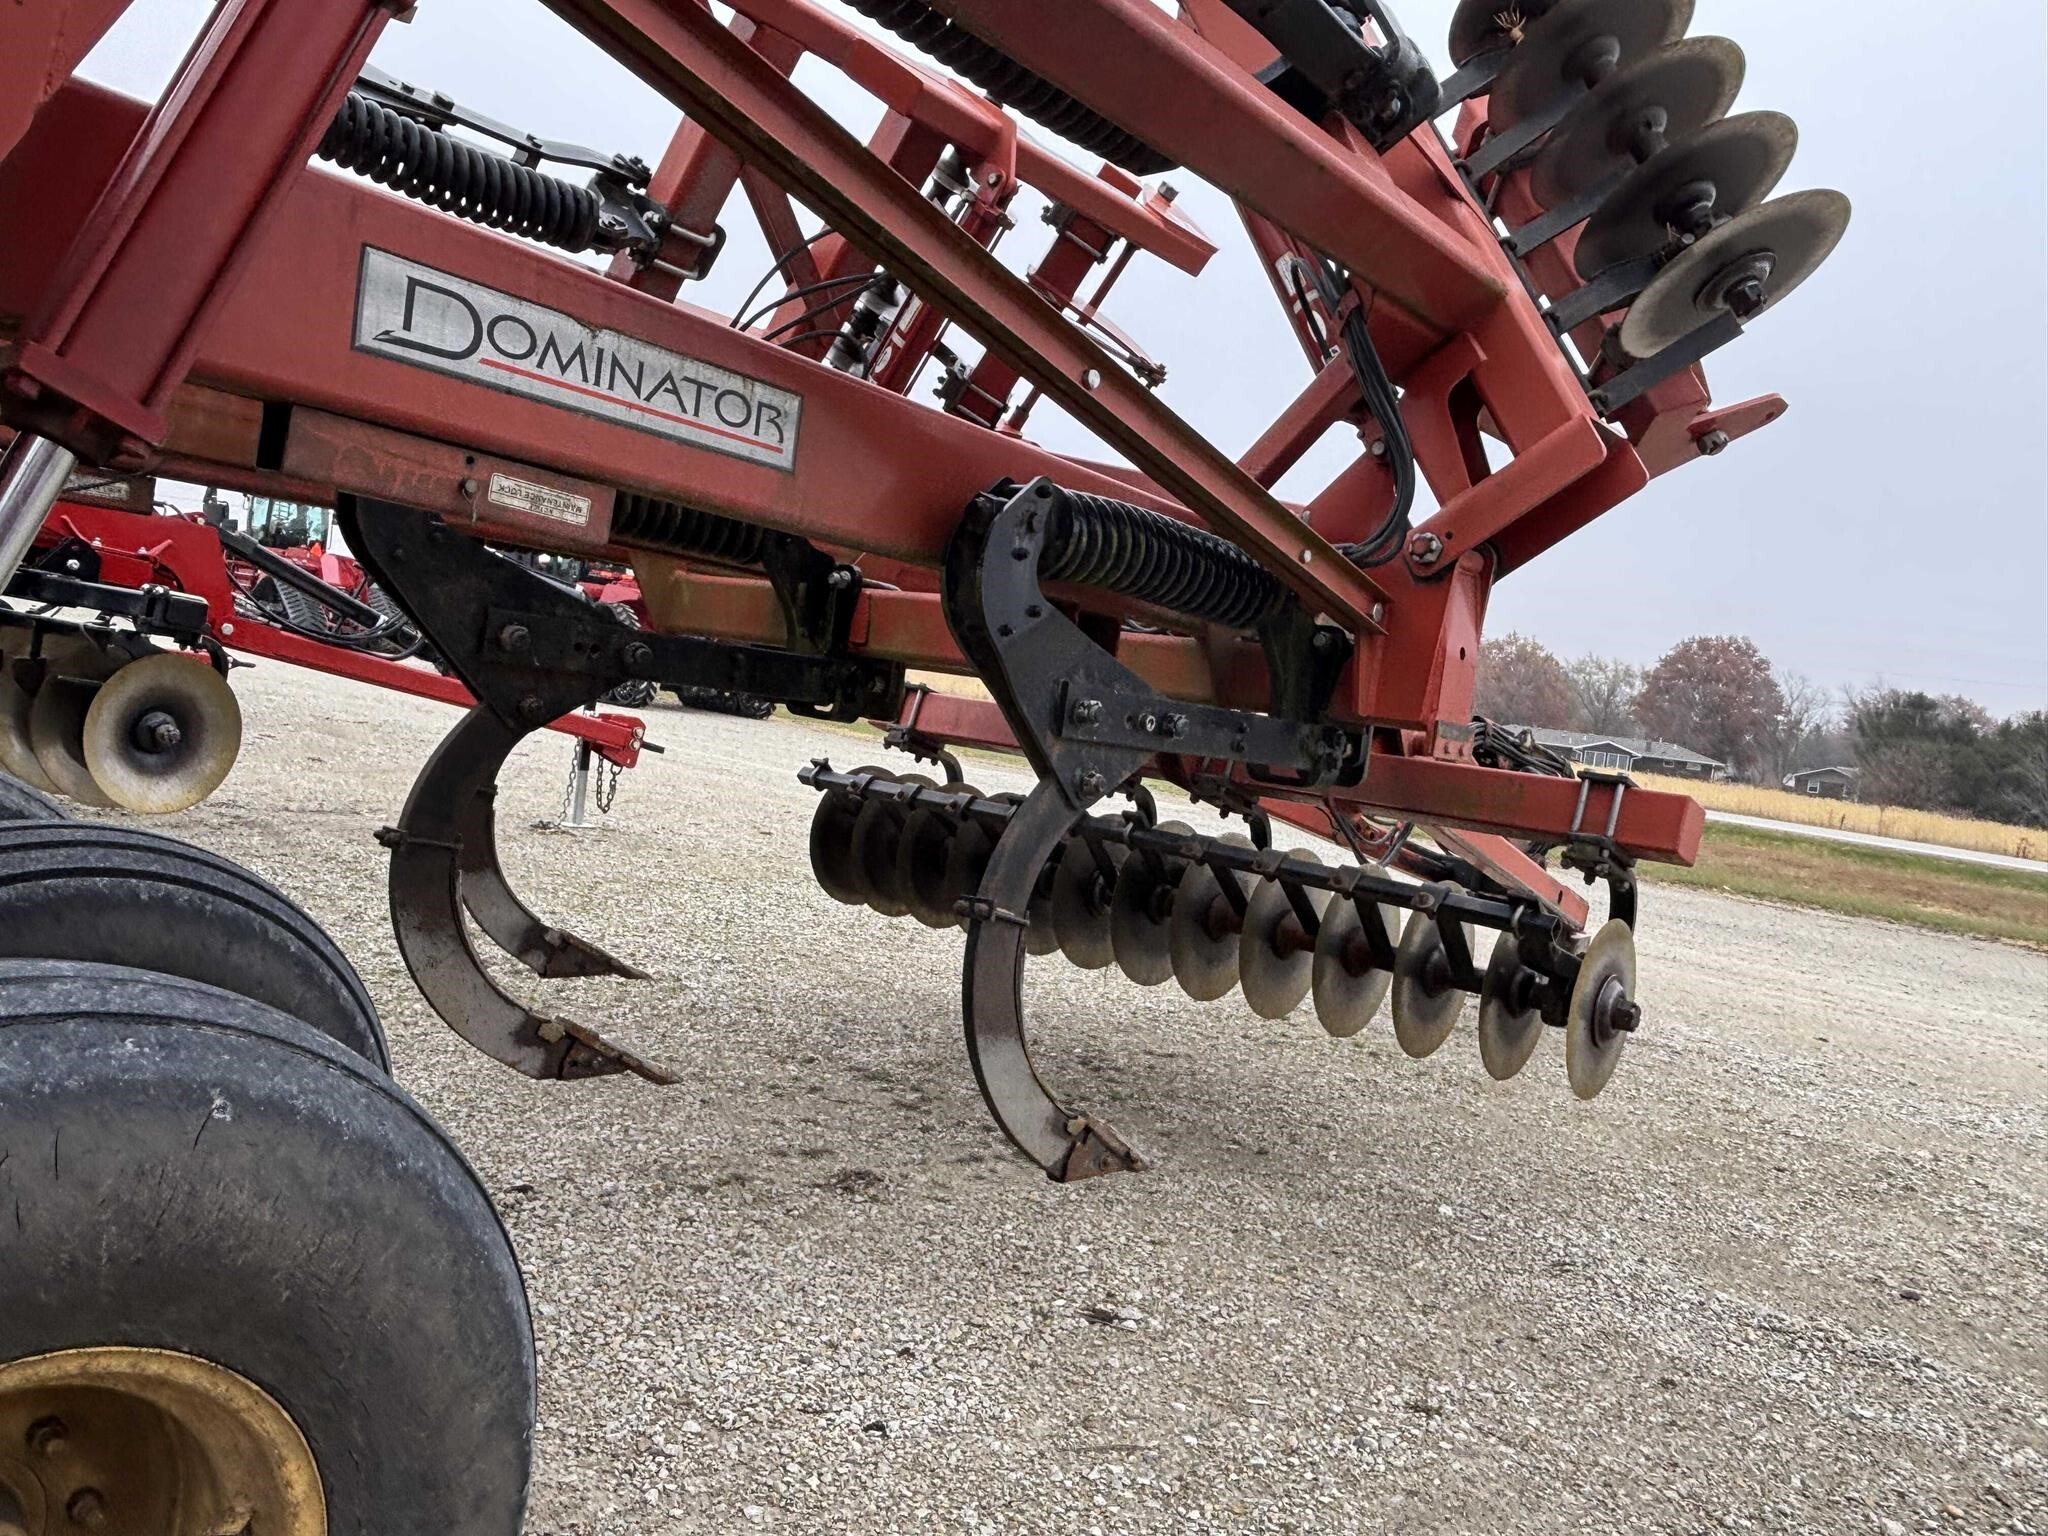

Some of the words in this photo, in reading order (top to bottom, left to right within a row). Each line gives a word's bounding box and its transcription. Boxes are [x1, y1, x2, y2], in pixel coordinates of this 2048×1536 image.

[372, 276, 784, 444] DOMINATOR
[498, 484, 522, 497] LOCK
[523, 490, 583, 513] MAINTENANCE
